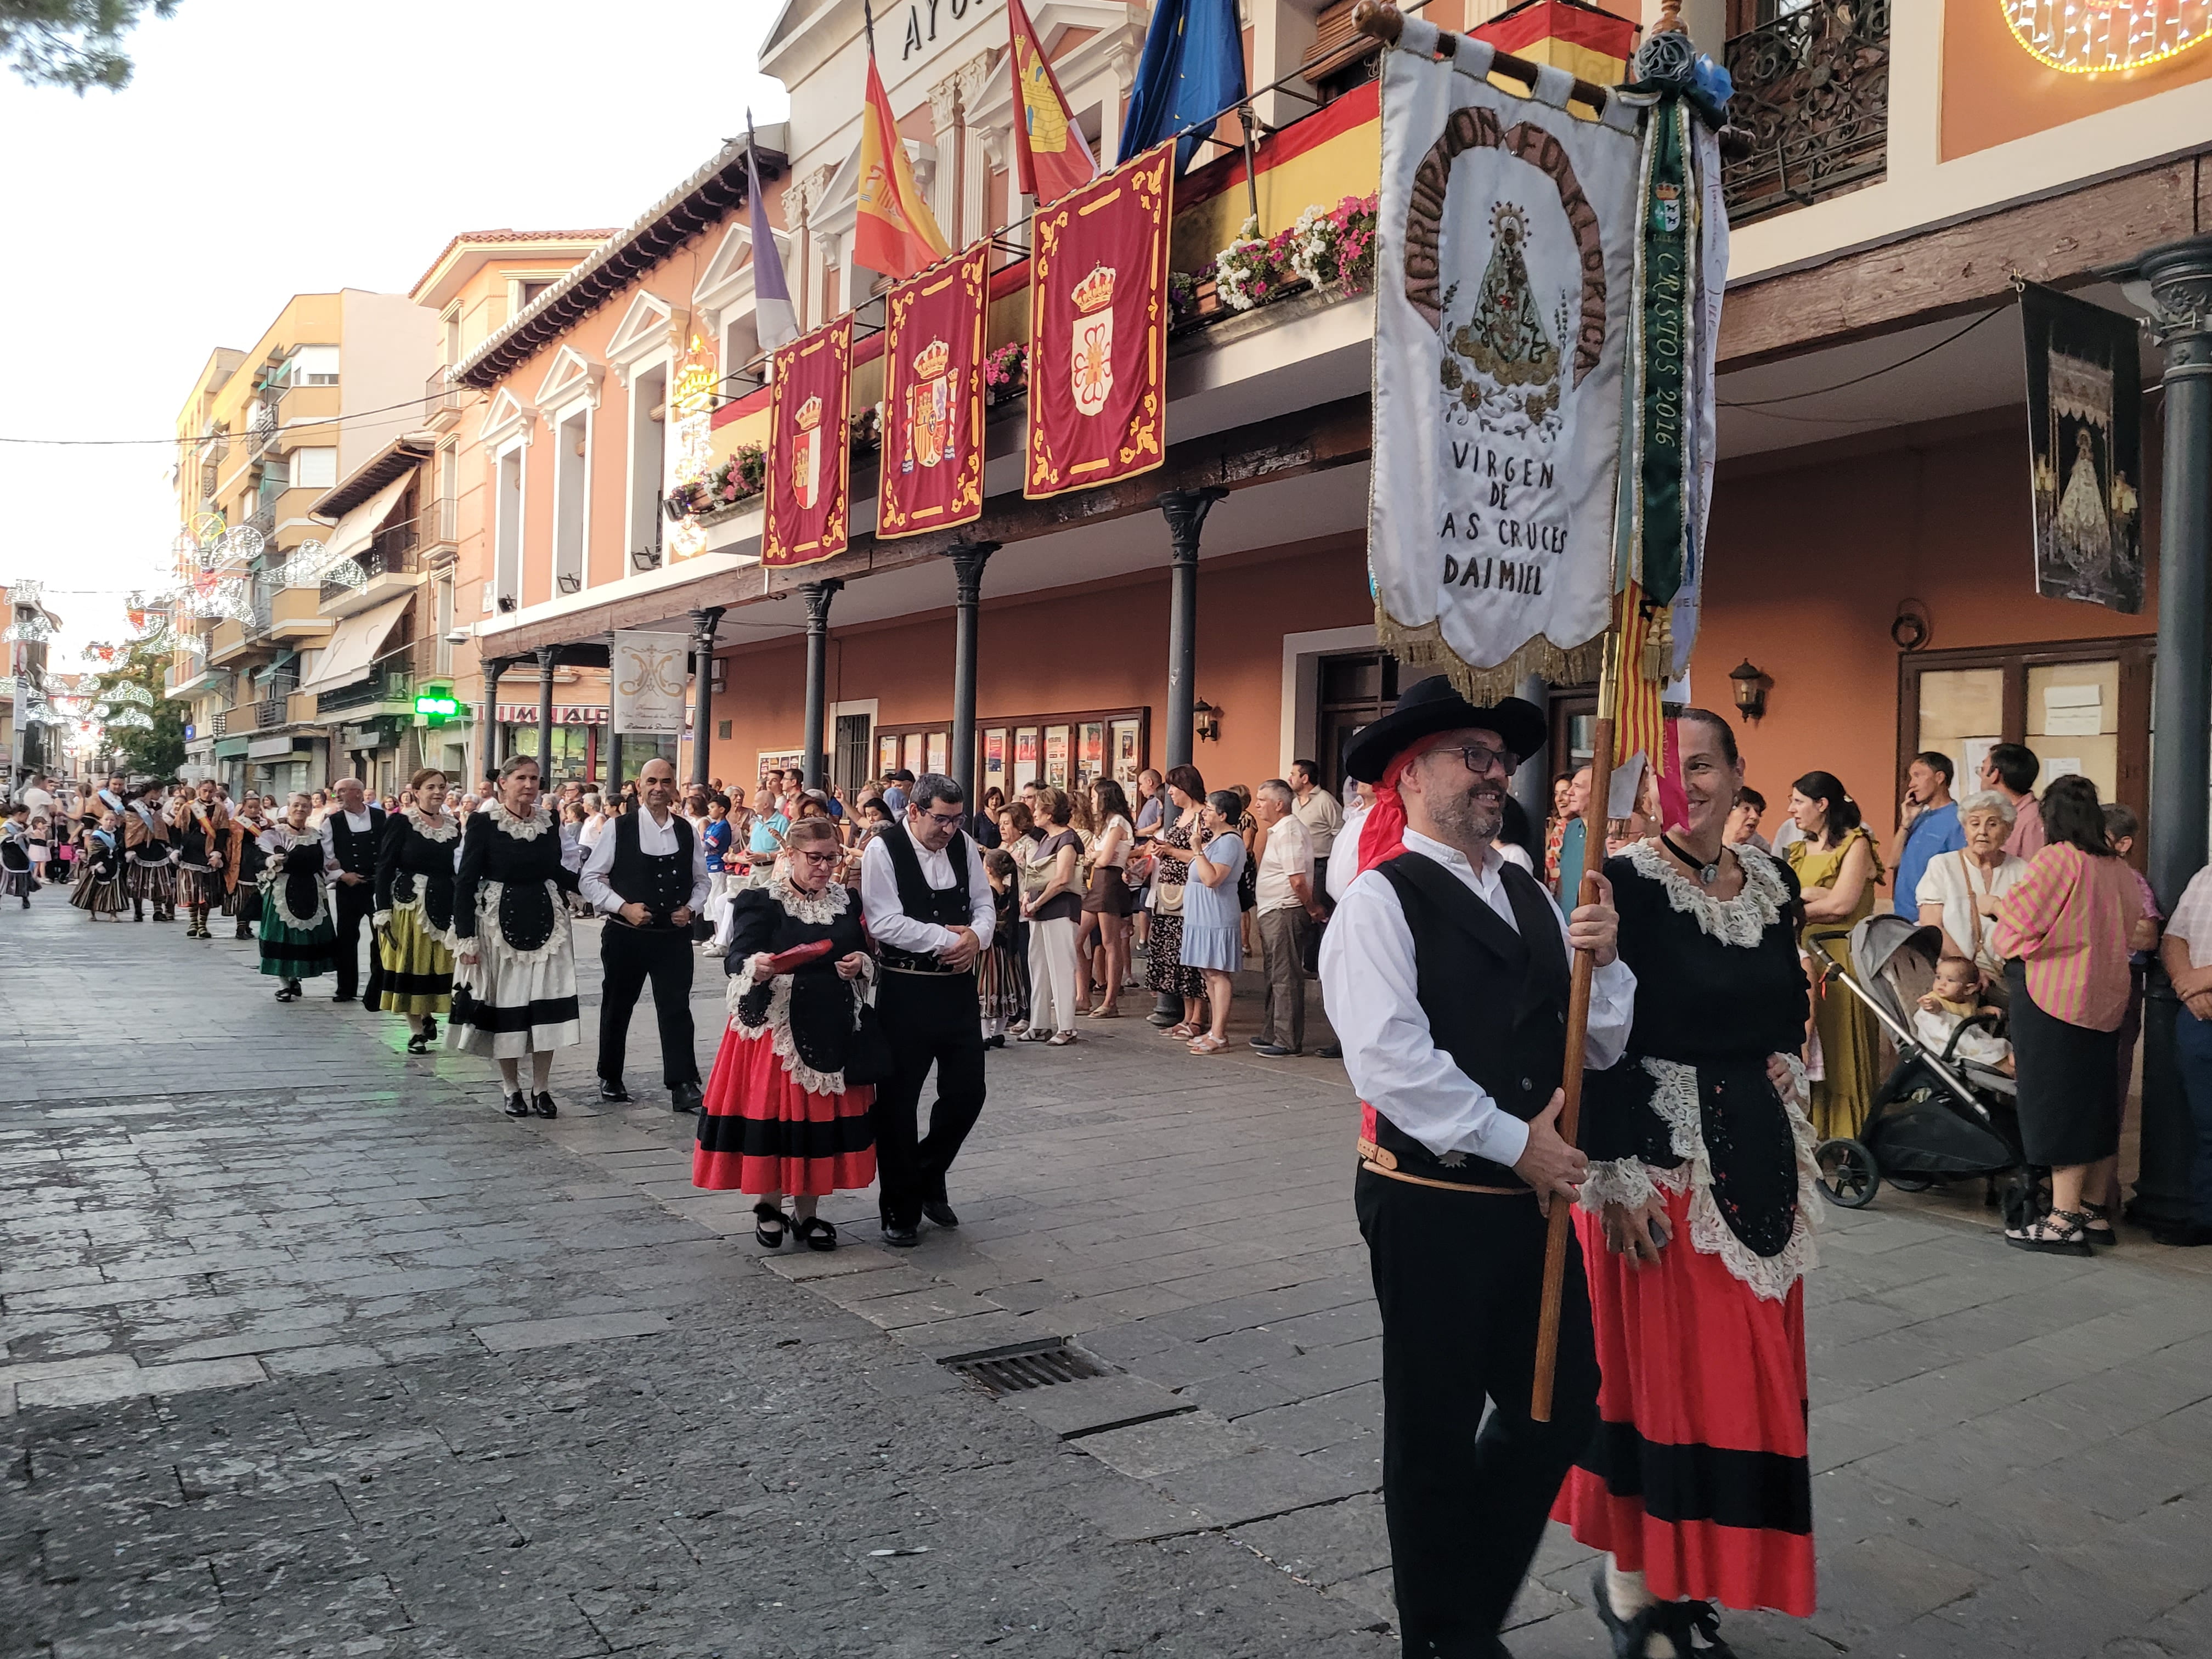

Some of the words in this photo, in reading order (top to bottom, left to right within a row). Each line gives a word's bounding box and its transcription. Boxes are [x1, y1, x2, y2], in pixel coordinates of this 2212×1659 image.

[1652, 252, 1680, 375] CRISTOS
[1655, 387, 1677, 448] 2016
[1452, 441, 1554, 488] VIRGEN
[1489, 481, 1509, 511] DE
[1437, 512, 1480, 540] AS
[1499, 519, 1567, 554] CRUCES
[1443, 554, 1542, 595] DAIMIEL
